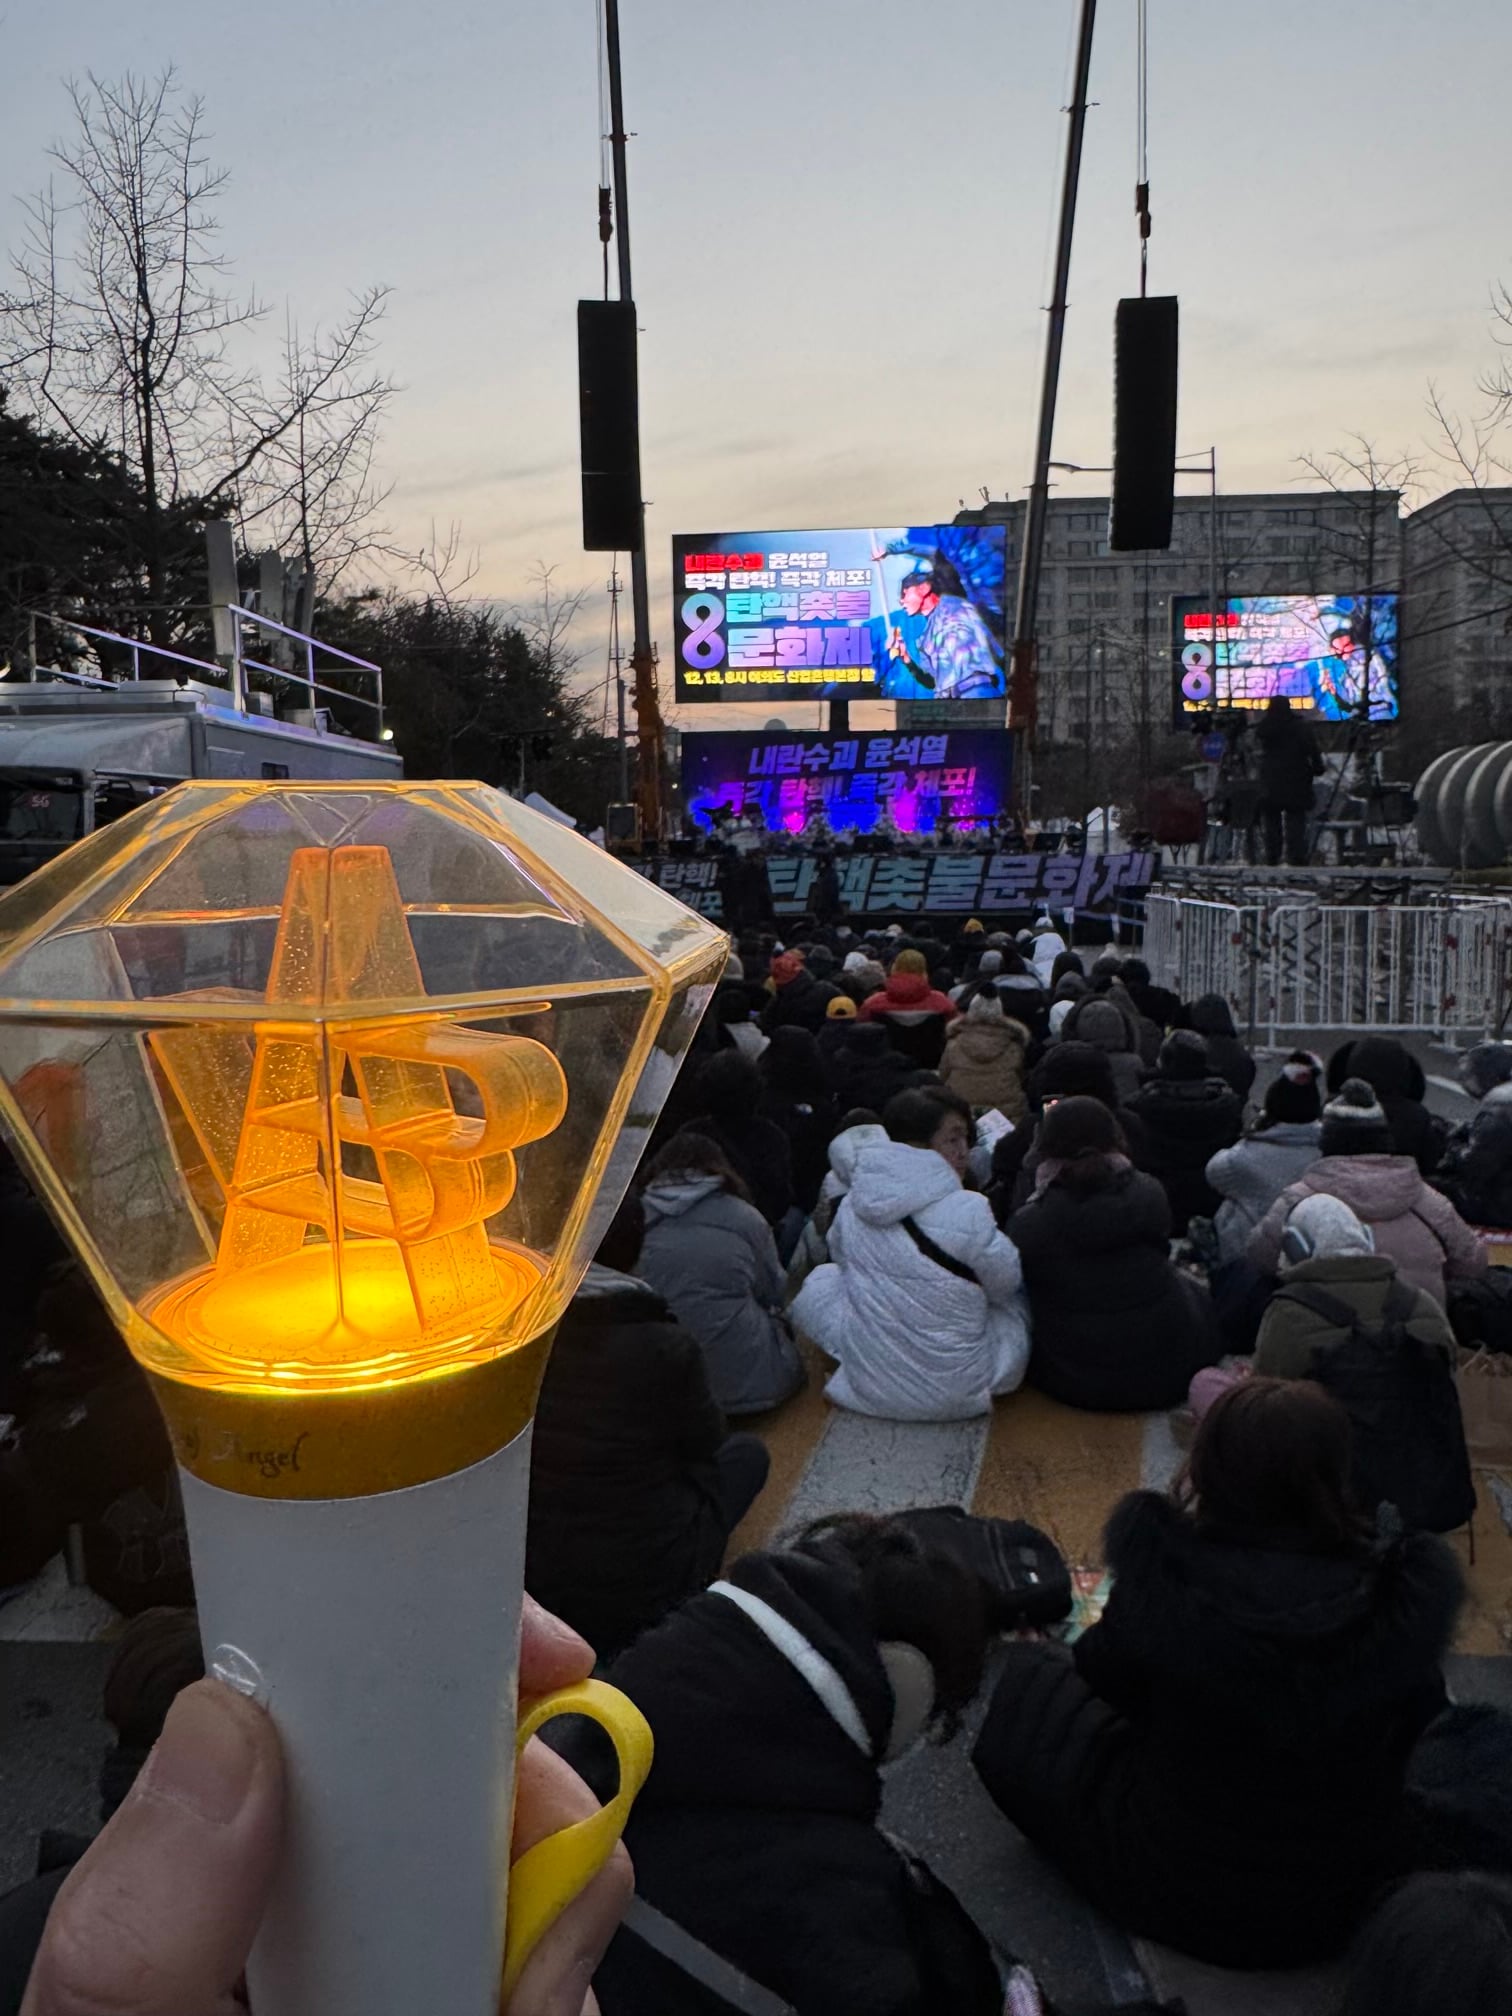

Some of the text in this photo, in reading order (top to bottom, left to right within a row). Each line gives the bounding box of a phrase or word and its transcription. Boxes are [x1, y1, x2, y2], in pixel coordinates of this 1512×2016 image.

[825, 569, 872, 586] 체포!
[727, 626, 873, 667] 문화제
[749, 734, 949, 775] 내란수괴 윤석열
[914, 766, 977, 797] 체포!
[659, 861, 718, 889] 탄핵!
